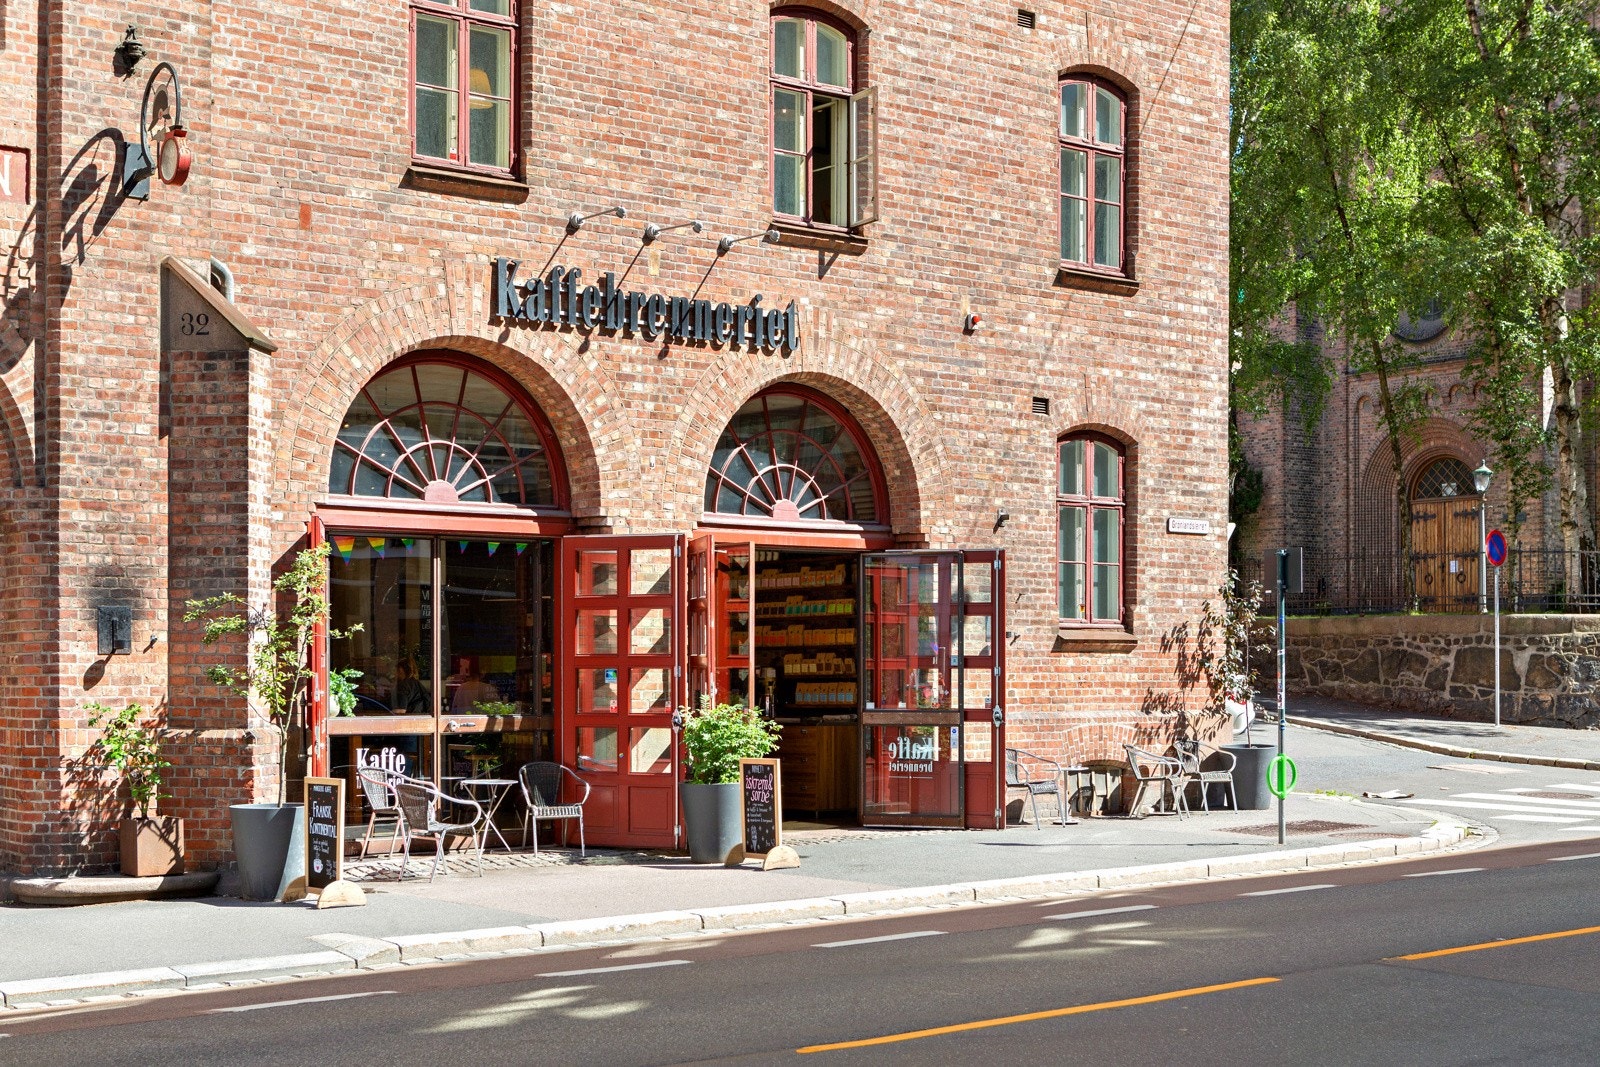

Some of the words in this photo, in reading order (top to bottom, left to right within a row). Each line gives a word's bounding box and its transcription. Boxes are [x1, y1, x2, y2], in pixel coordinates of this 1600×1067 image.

[496, 256, 800, 352] Kaffebrenneriet
[181, 312, 210, 336] 32
[356, 747, 406, 774] Kaffe
